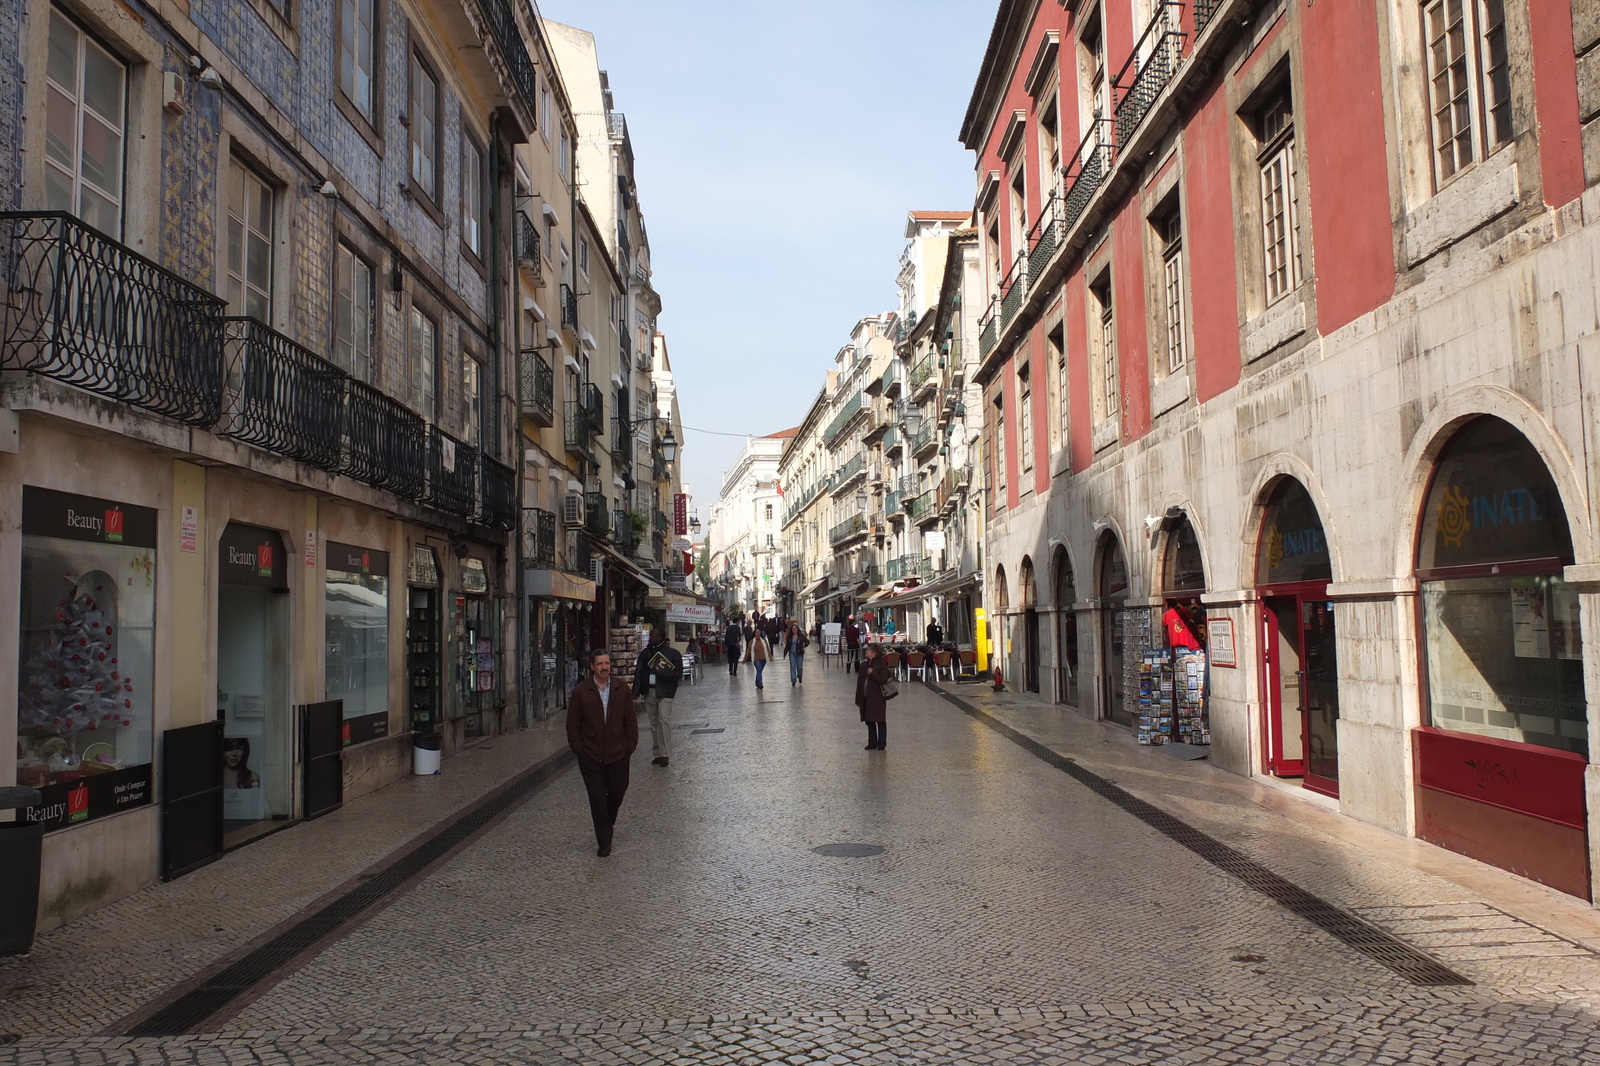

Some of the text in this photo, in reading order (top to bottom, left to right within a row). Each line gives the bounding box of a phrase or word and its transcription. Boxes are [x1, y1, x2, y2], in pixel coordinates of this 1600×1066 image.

[67, 508, 103, 536] Beauty
[229, 545, 257, 572] Beauty
[684, 606, 710, 616] Milano
[1462, 689, 1484, 702] INATEL
[114, 784, 127, 795] Onde
[129, 791, 144, 802] Prazer
[26, 802, 66, 823] Beauty
